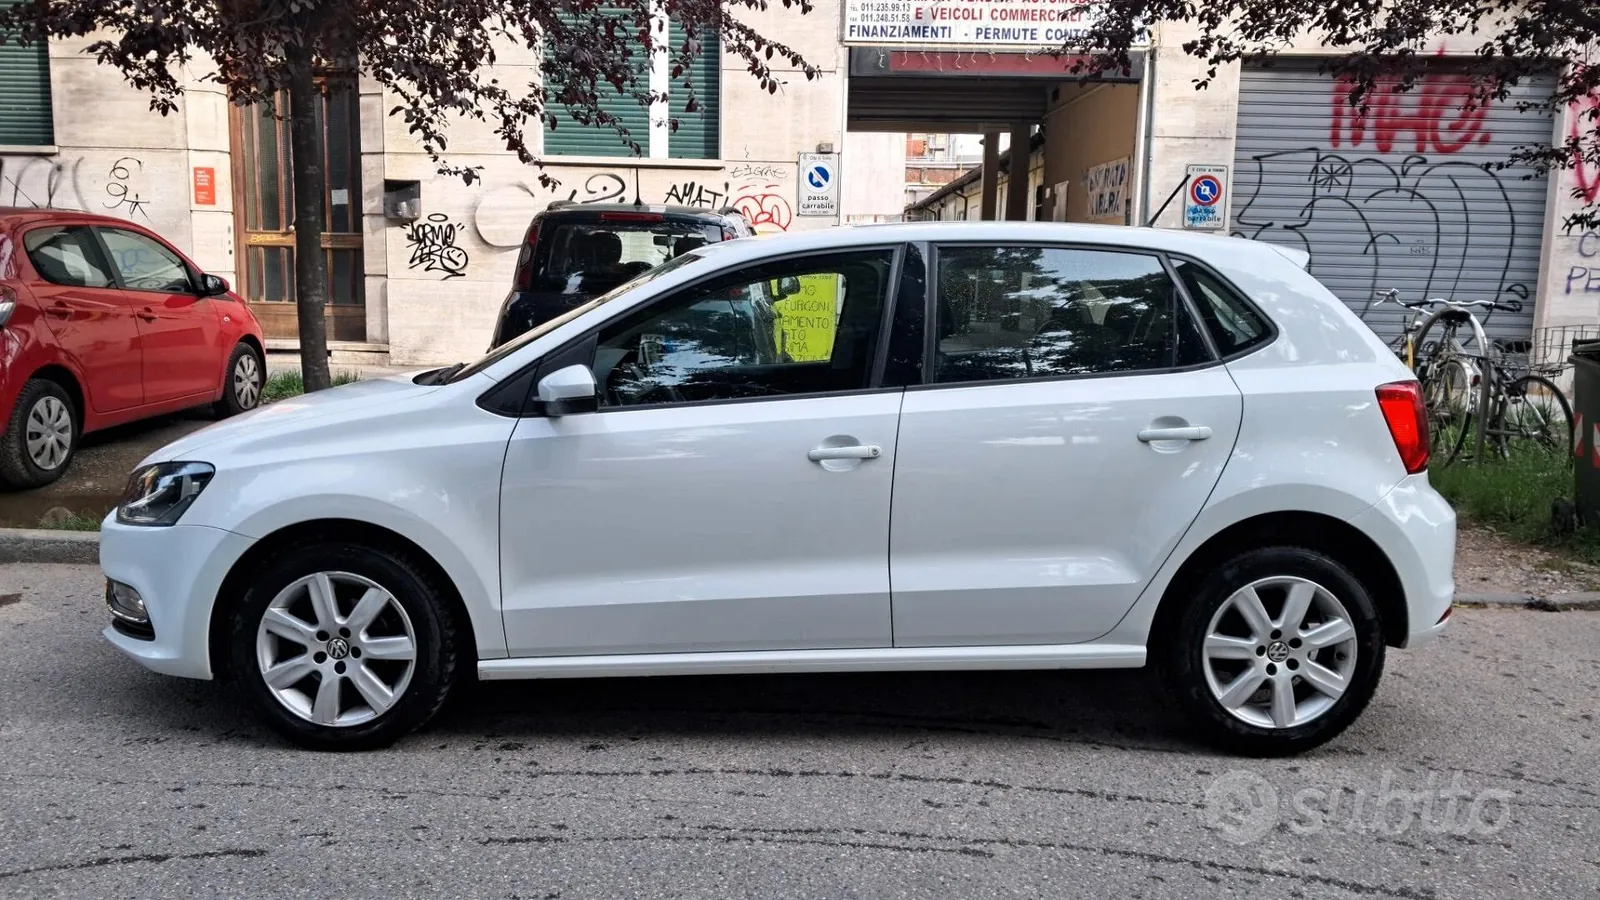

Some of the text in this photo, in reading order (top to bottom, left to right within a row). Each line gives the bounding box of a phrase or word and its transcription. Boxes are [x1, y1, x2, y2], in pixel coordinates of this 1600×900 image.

[860, 2, 911, 12] 011.235.99.13
[860, 13, 911, 23] 011.248.51.58
[915, 7, 923, 20] E
[930, 7, 983, 20] VEICOLI
[849, 24, 952, 38] FINANZIAMENTI
[975, 27, 1038, 41] PERMUTE
[801, 202, 835, 210] carrabile
